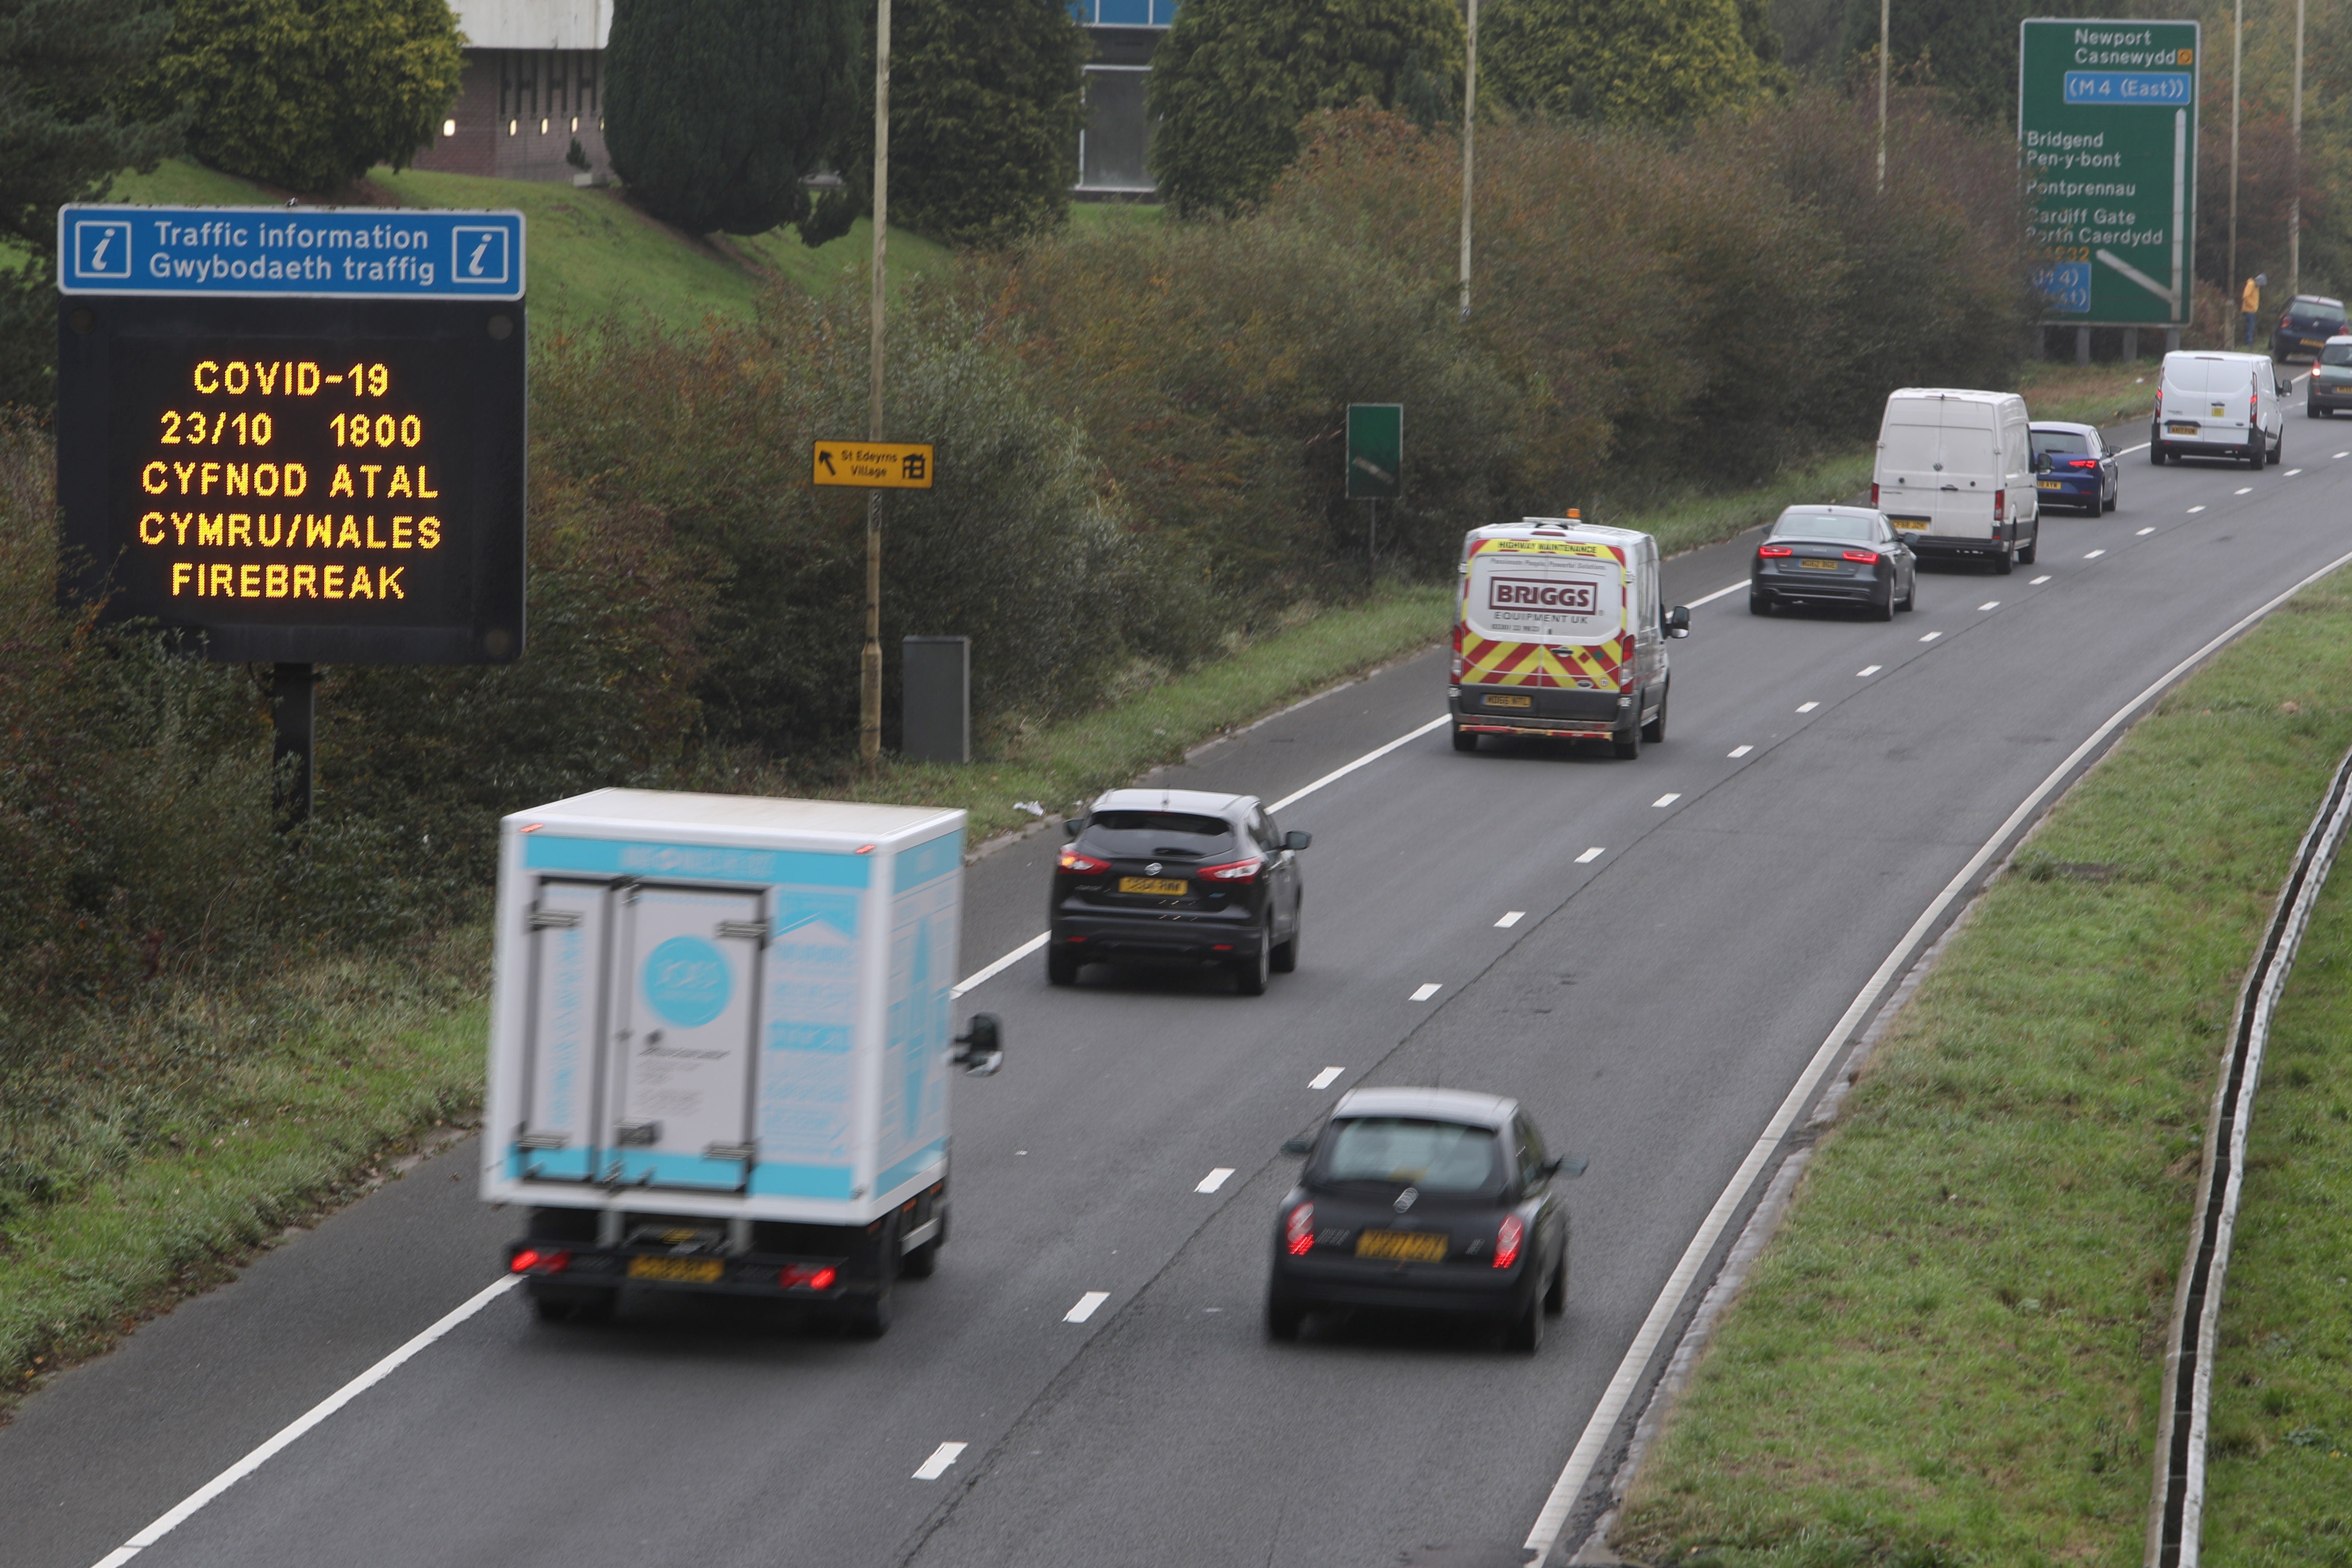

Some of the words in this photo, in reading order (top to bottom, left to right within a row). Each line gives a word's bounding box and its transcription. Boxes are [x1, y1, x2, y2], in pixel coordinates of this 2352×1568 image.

[2075, 28, 2151, 47] Newport
[2075, 47, 2176, 68] Casnewydd
[2121, 78, 2184, 98] (East))
[2027, 131, 2103, 150] Bridgend
[2027, 150, 2121, 169] Pen-y-bont
[2026, 179, 2136, 198] Pontprennau
[2094, 208, 2136, 225] Gate
[155, 222, 248, 247] Traffic
[259, 224, 429, 249] information
[2078, 227, 2162, 247] Caerdydd
[149, 254, 332, 282] Gwybodaeth
[344, 257, 435, 286] traffig
[193, 361, 389, 397] COVID-19
[161, 411, 272, 446] 23/10
[330, 414, 421, 448] 1800
[842, 450, 853, 460] St
[142, 462, 307, 497] CYFNOD
[330, 465, 438, 498] ATAL
[851, 465, 887, 478] Village
[140, 512, 441, 549] CYMRU/WALES
[1498, 541, 1536, 550] HIGHWAY
[1538, 543, 1597, 554] MAINTENANCE
[172, 563, 405, 600] FIREBREAK
[1497, 585, 1590, 607] BRIGGS
[1494, 611, 1568, 623] EQUIPMENT
